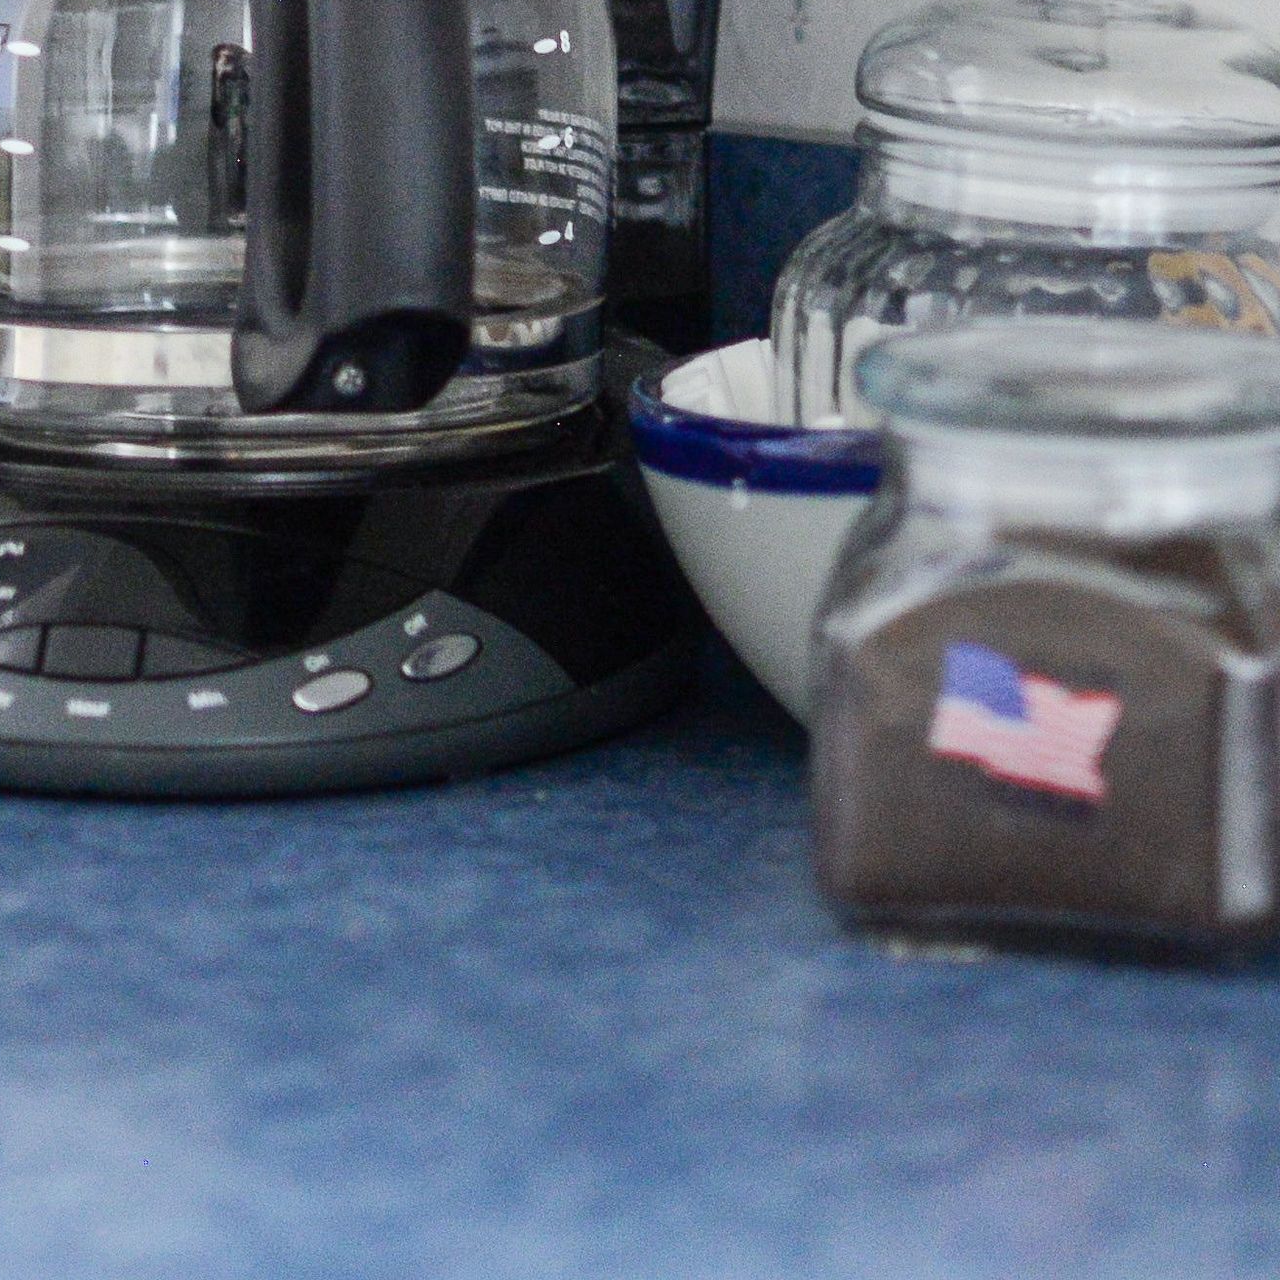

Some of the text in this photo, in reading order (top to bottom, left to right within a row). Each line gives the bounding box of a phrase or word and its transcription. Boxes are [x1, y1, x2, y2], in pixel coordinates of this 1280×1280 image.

[559, 30, 571, 53] 8
[564, 126, 574, 149] 6
[564, 220, 575, 241] 4
